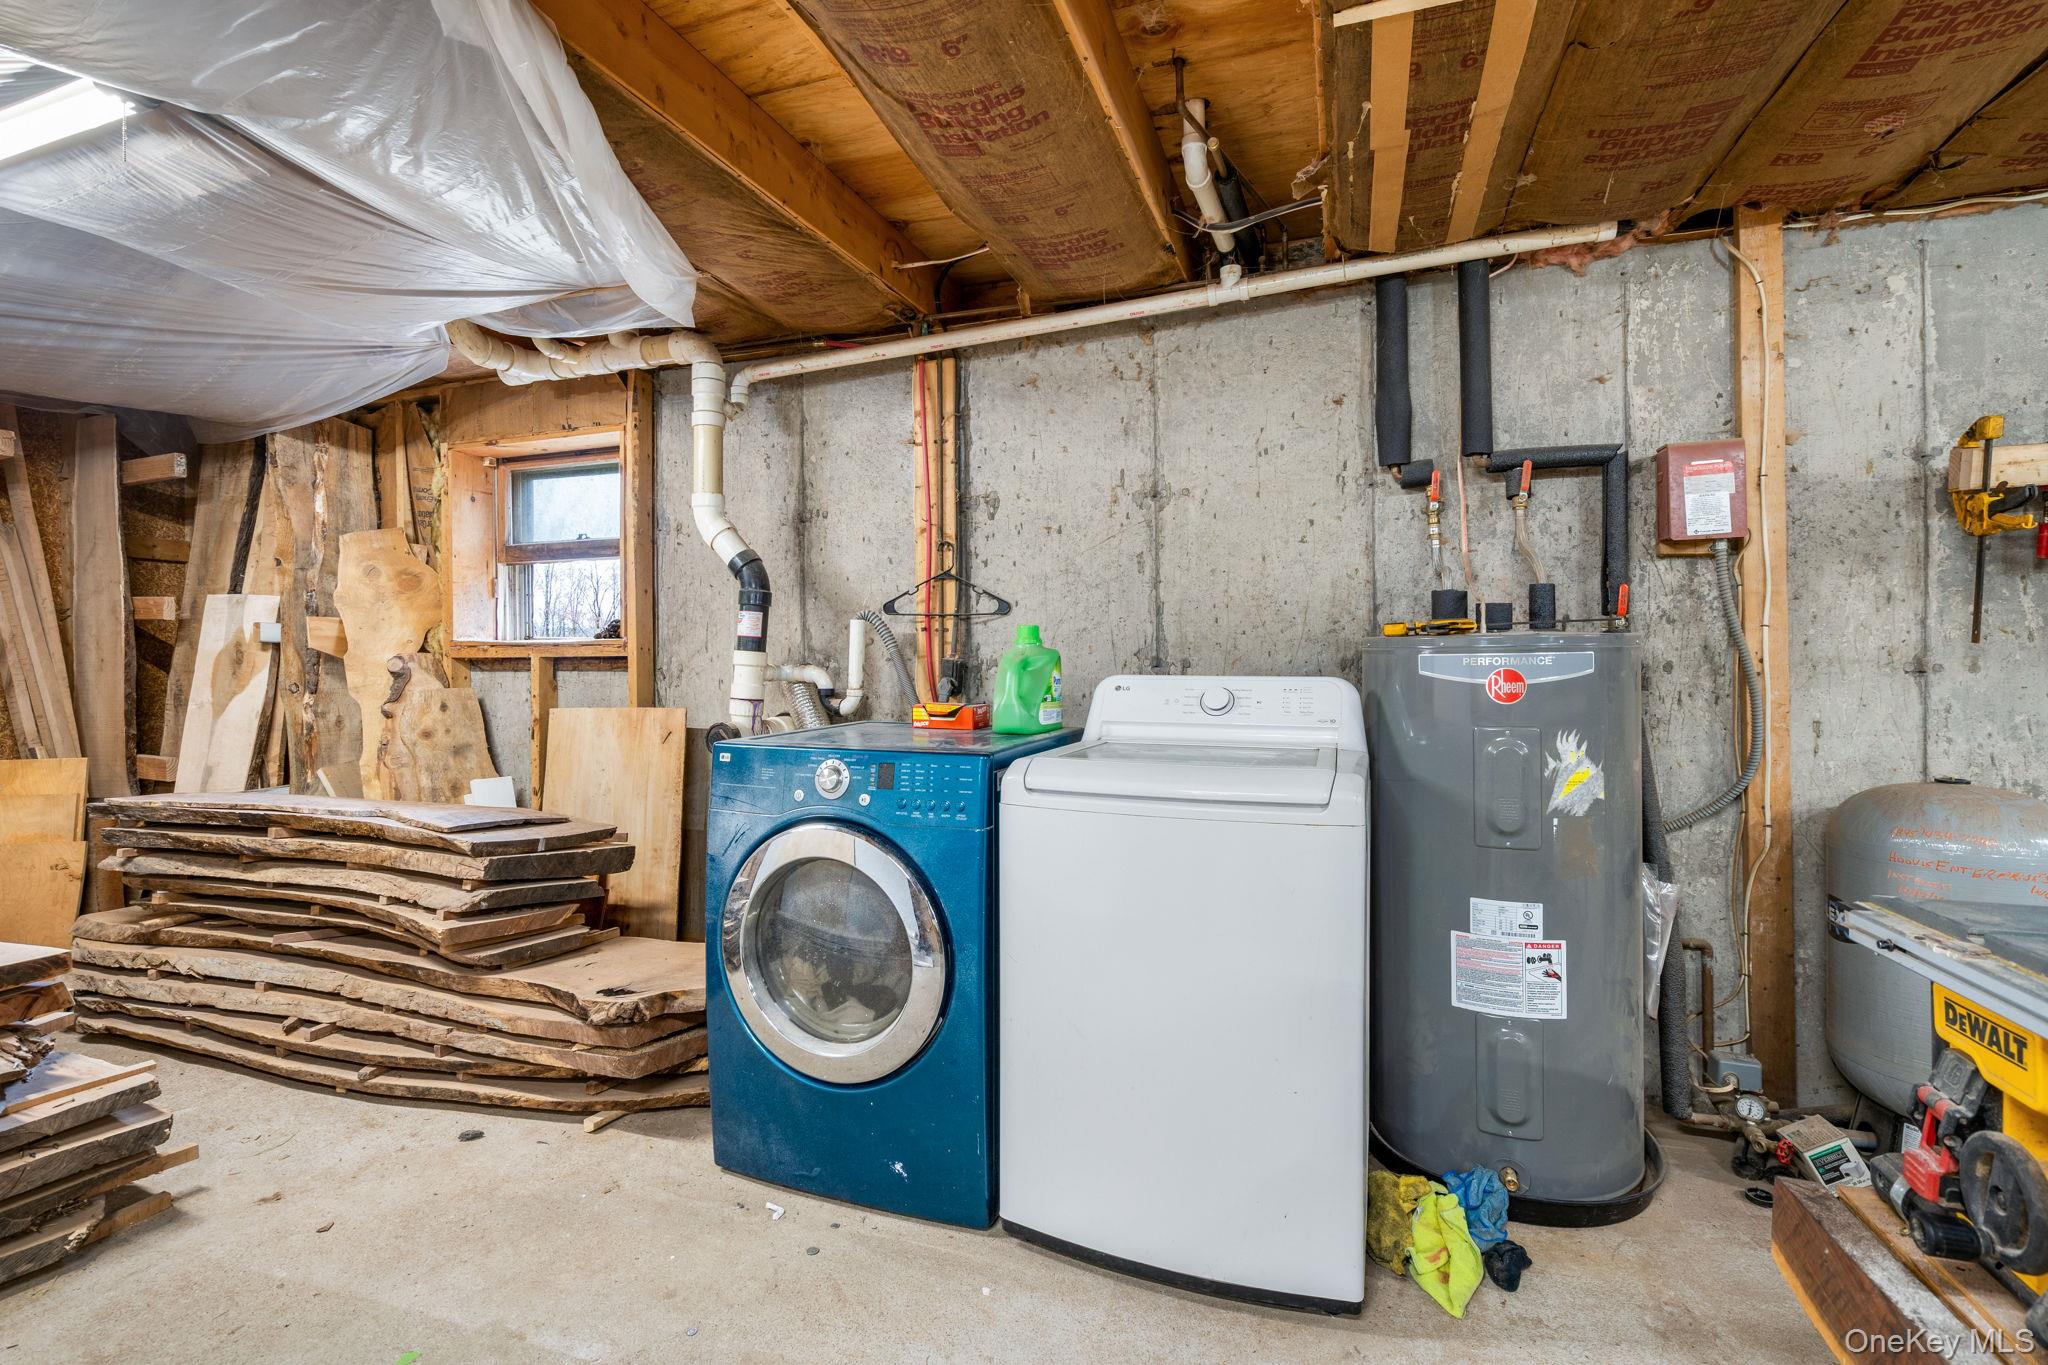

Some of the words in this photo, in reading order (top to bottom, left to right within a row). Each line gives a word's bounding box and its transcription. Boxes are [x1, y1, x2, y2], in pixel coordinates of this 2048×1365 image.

[1858, 17, 2048, 62] Insulation
[1873, 3, 2044, 44] Building
[1463, 656, 1554, 667] PERFORMANCE
[1491, 669, 1525, 699] Rheem
